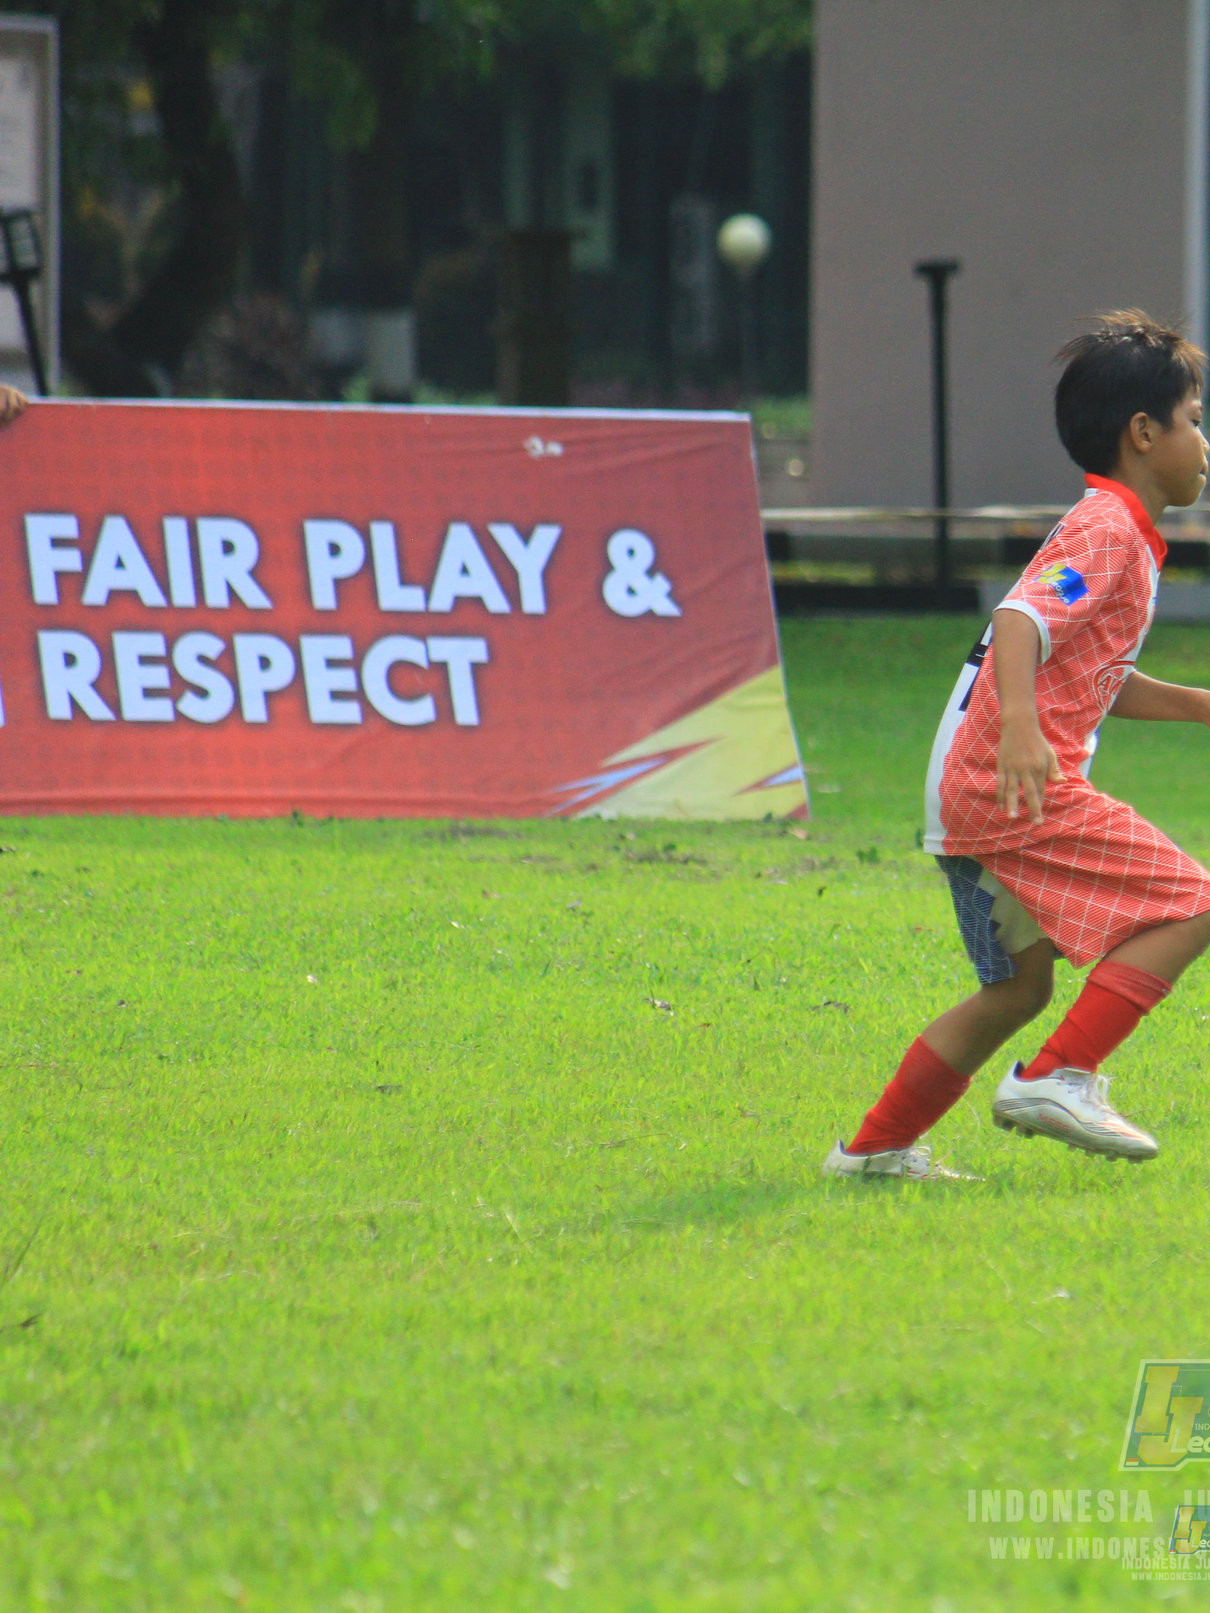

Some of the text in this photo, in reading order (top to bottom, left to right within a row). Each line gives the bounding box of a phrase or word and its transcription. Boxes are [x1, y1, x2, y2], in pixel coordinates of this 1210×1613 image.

[25, 513, 682, 617] FAIR PLAY &
[38, 629, 489, 727] RESPECT
